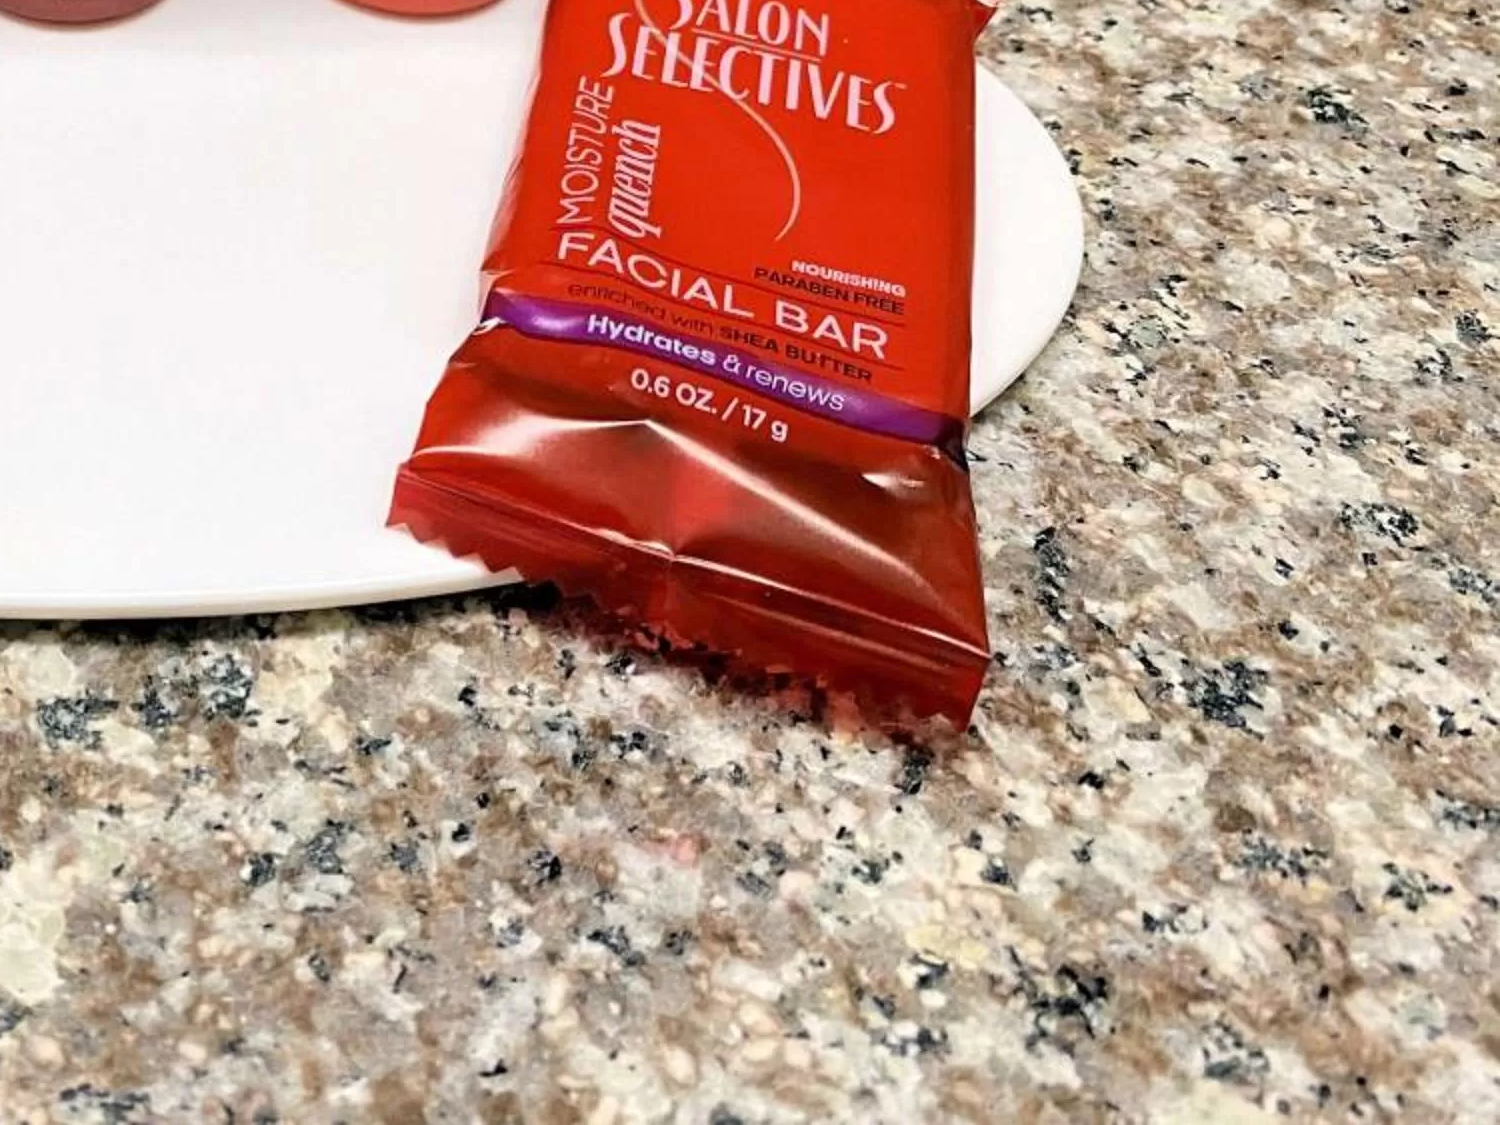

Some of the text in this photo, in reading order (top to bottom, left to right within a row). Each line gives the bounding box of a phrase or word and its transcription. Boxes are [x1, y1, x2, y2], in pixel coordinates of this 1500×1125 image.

[601, 12, 902, 135] SELECTIVES
[556, 76, 615, 224] MOISTURE
[607, 119, 661, 238] quench
[557, 231, 889, 361] FACIAL BAR
[754, 266, 905, 317] PARABEN FREE
[791, 259, 906, 298] NOURISHING
[567, 283, 873, 383] enriched with SHEA BUTTER
[587, 313, 845, 412] Hydrates & renews
[630, 367, 670, 400] 0.6
[675, 381, 718, 416] OZ.
[742, 404, 768, 431] 17
[771, 418, 790, 442] g
